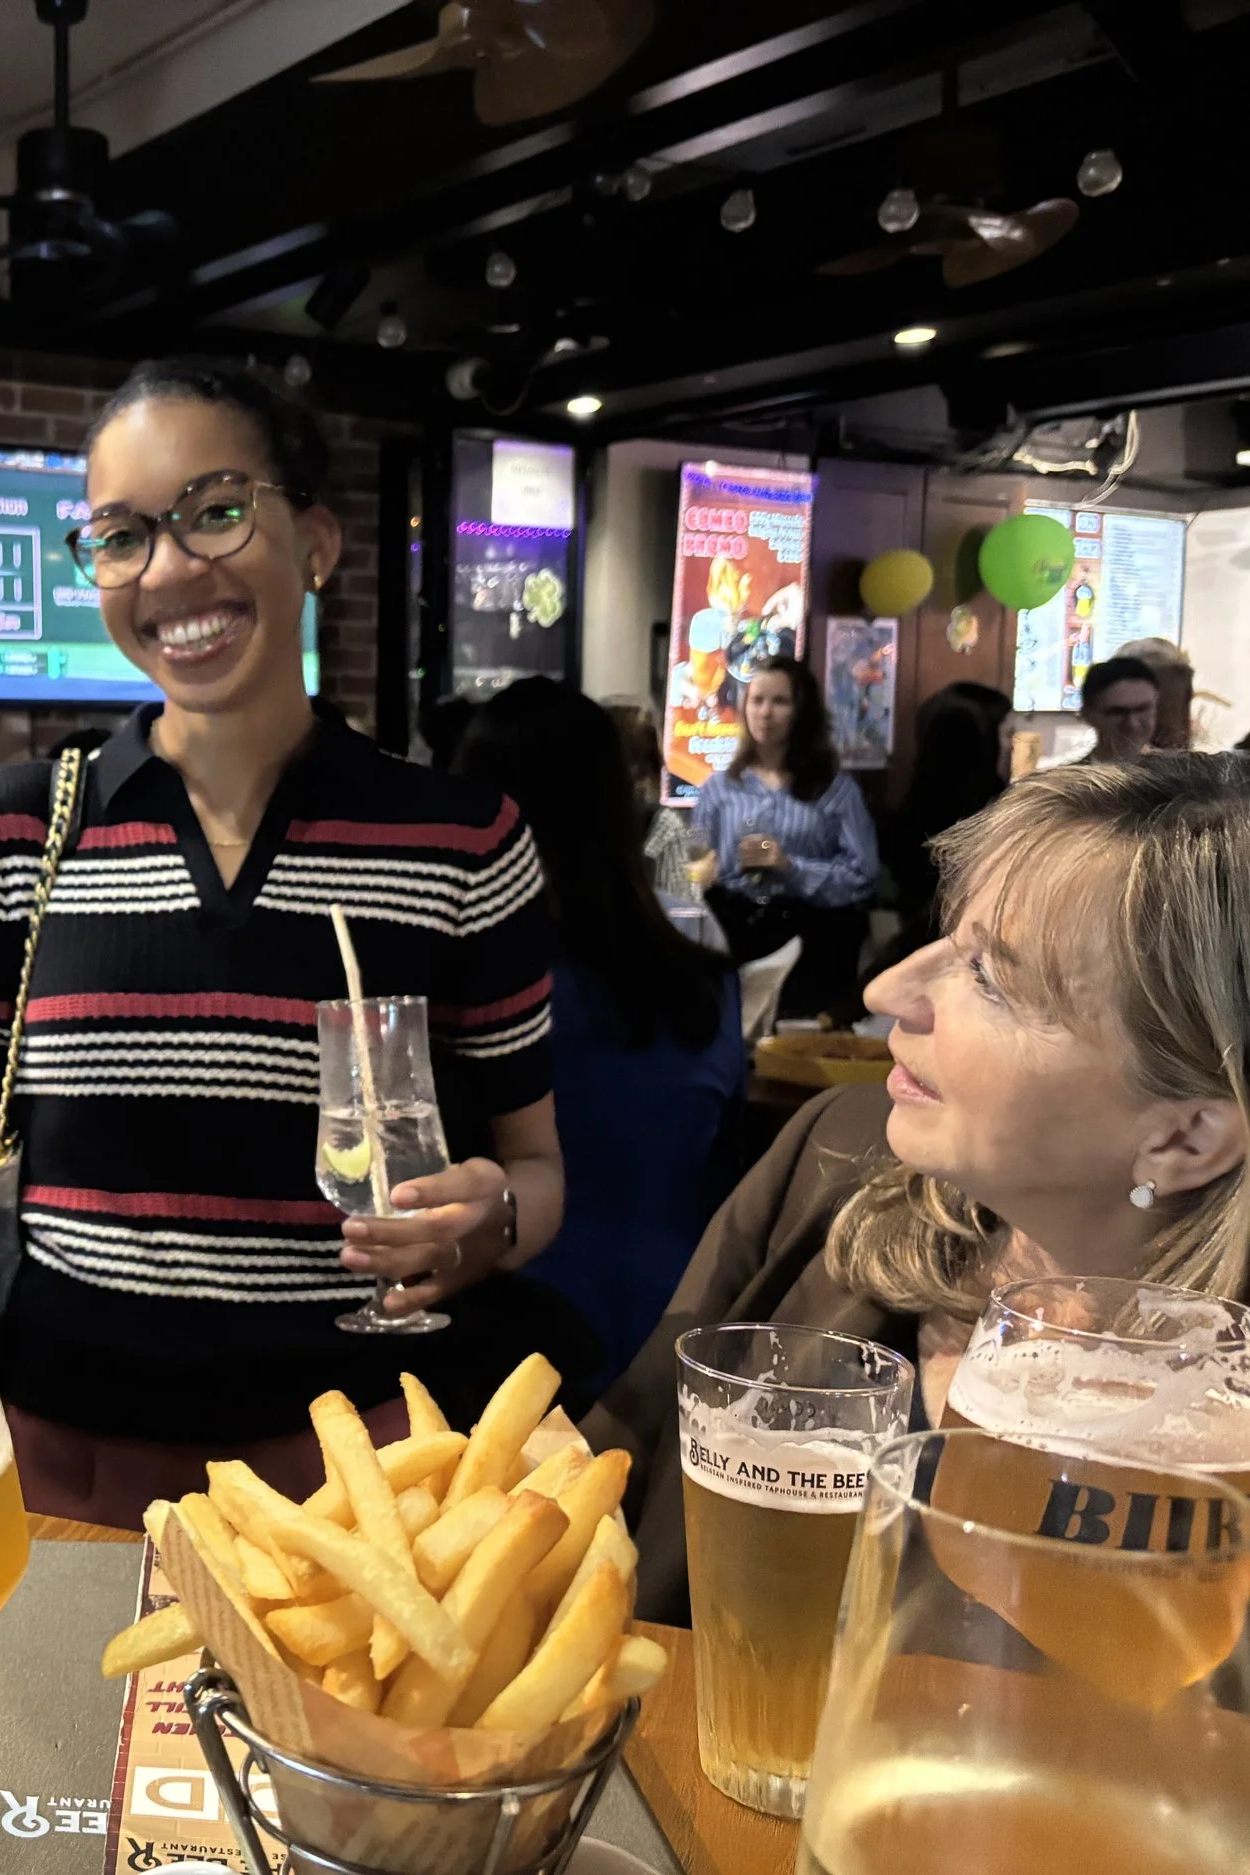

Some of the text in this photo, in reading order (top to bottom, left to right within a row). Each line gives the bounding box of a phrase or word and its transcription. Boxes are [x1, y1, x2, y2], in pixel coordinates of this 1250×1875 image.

[690, 1437, 730, 1471] BELLY
[737, 1461, 780, 1483] AND
[787, 1470, 827, 1489] THE
[700, 1463, 724, 1479] BELGIAN
[726, 1475, 762, 1490] INSPIRED
[765, 1485, 807, 1498] TAPHOUSE
[819, 1490, 863, 1499] RESTAURAN
[1032, 1479, 1243, 1556] BIIR
[47, 1796, 111, 1809] URANT
[161, 1842, 242, 1857] ESTAURANT
